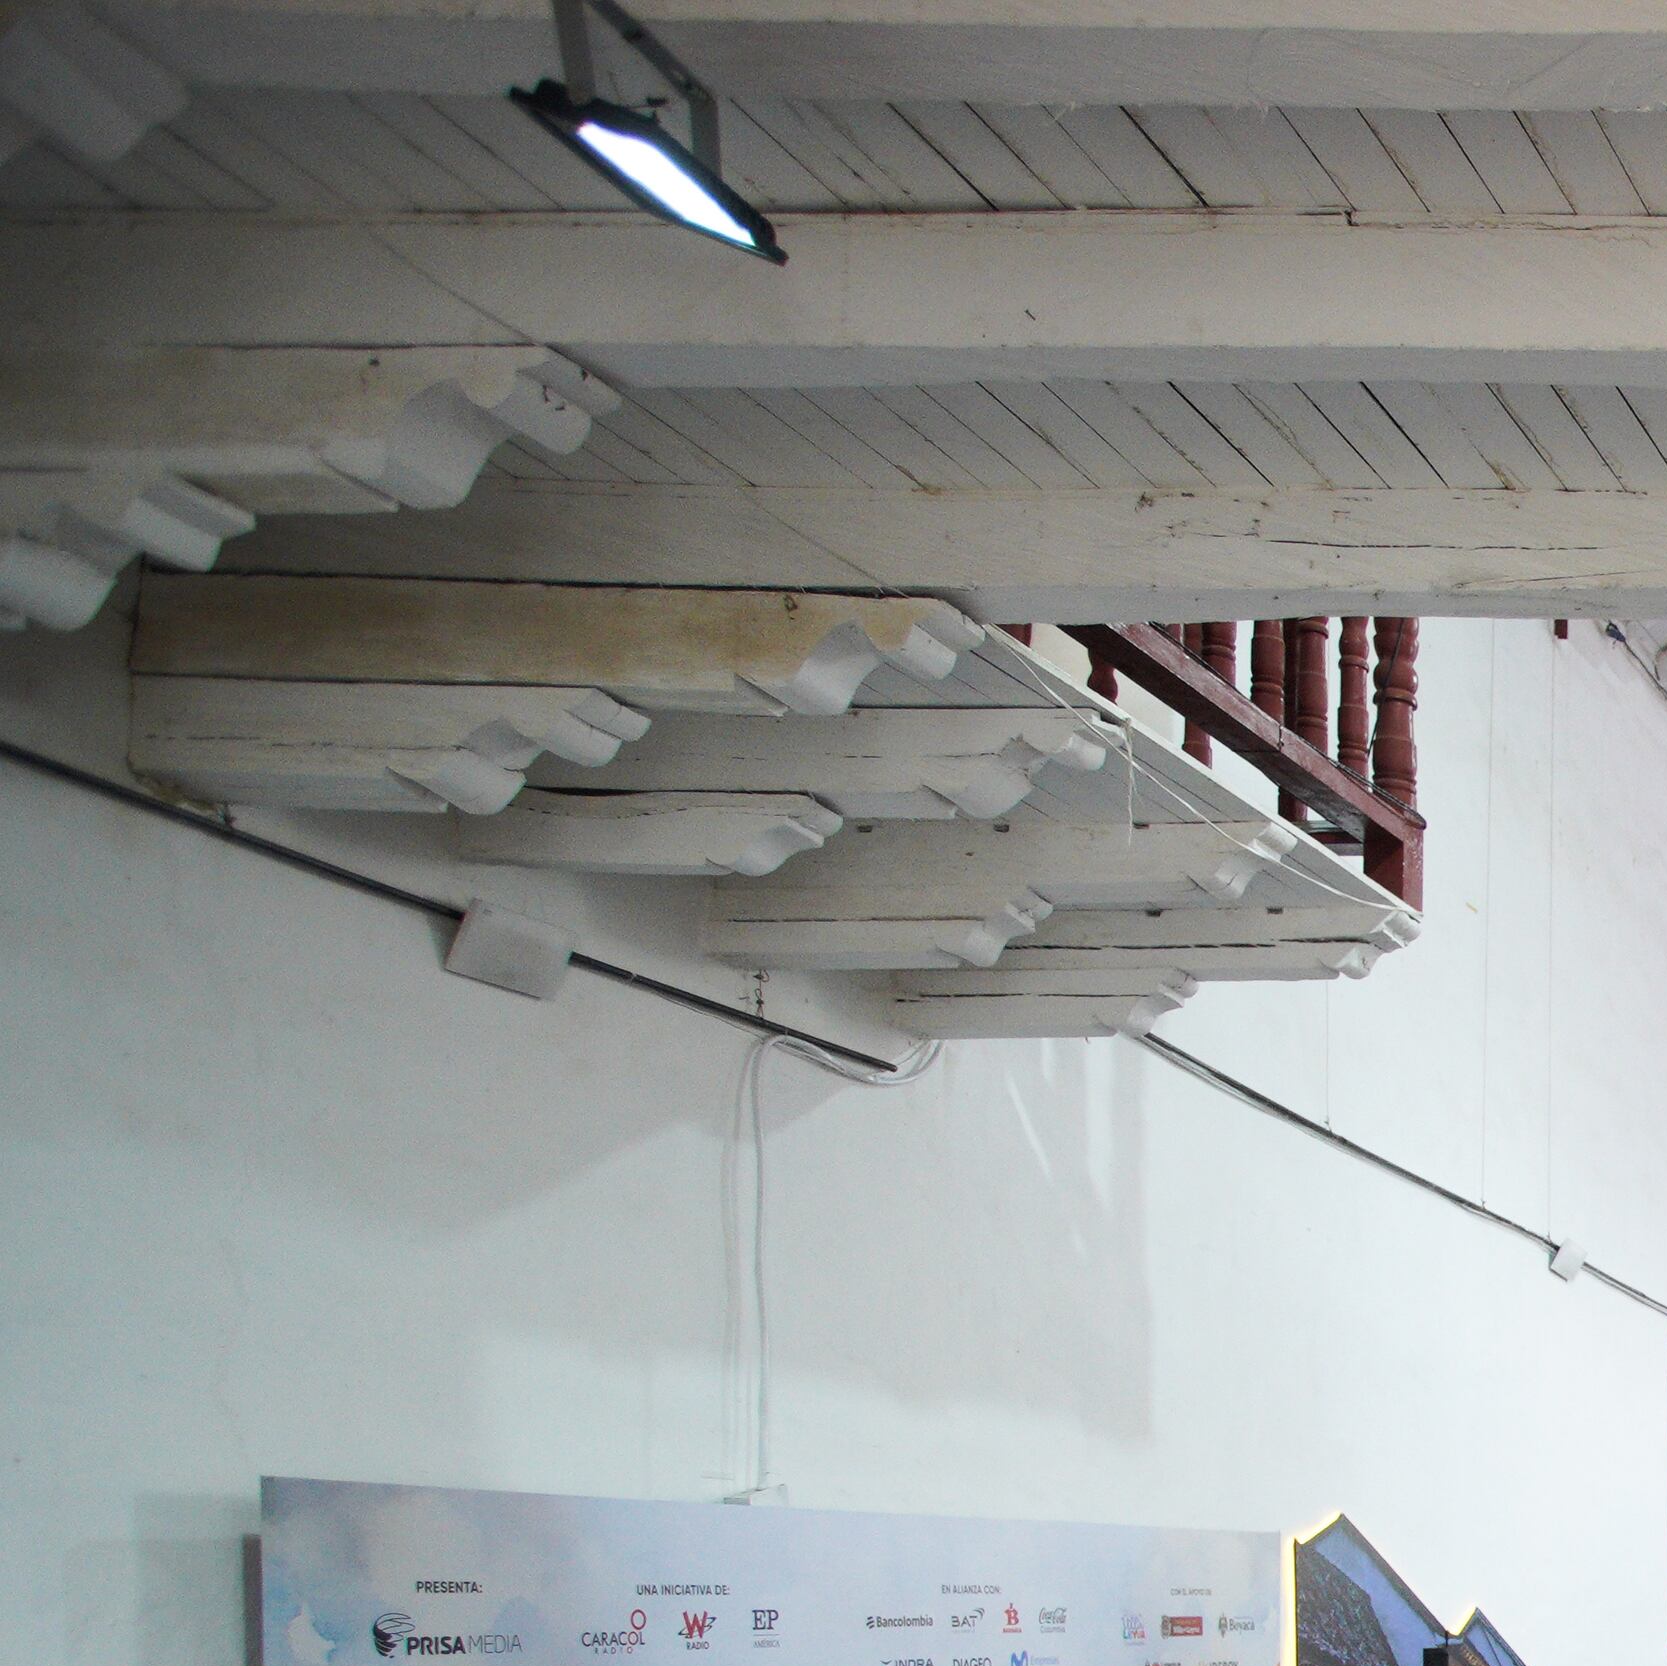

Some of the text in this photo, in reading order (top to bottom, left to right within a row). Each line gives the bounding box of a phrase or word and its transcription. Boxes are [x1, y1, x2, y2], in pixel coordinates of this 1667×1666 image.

[416, 1581, 483, 1594] PRESENTA:
[636, 1584, 731, 1596] UNA INICIATIVA DE:
[941, 1584, 951, 1594] EN
[952, 1584, 983, 1594] ALIANZA
[752, 1609, 779, 1631] EP
[876, 1614, 934, 1628] Bancolombia
[951, 1615, 978, 1628] BAT
[407, 1634, 523, 1656] PRISA MEDIA
[581, 1631, 646, 1647] CARACOL
[686, 1641, 710, 1650] RADIO
[593, 1646, 634, 1655] RADIO
